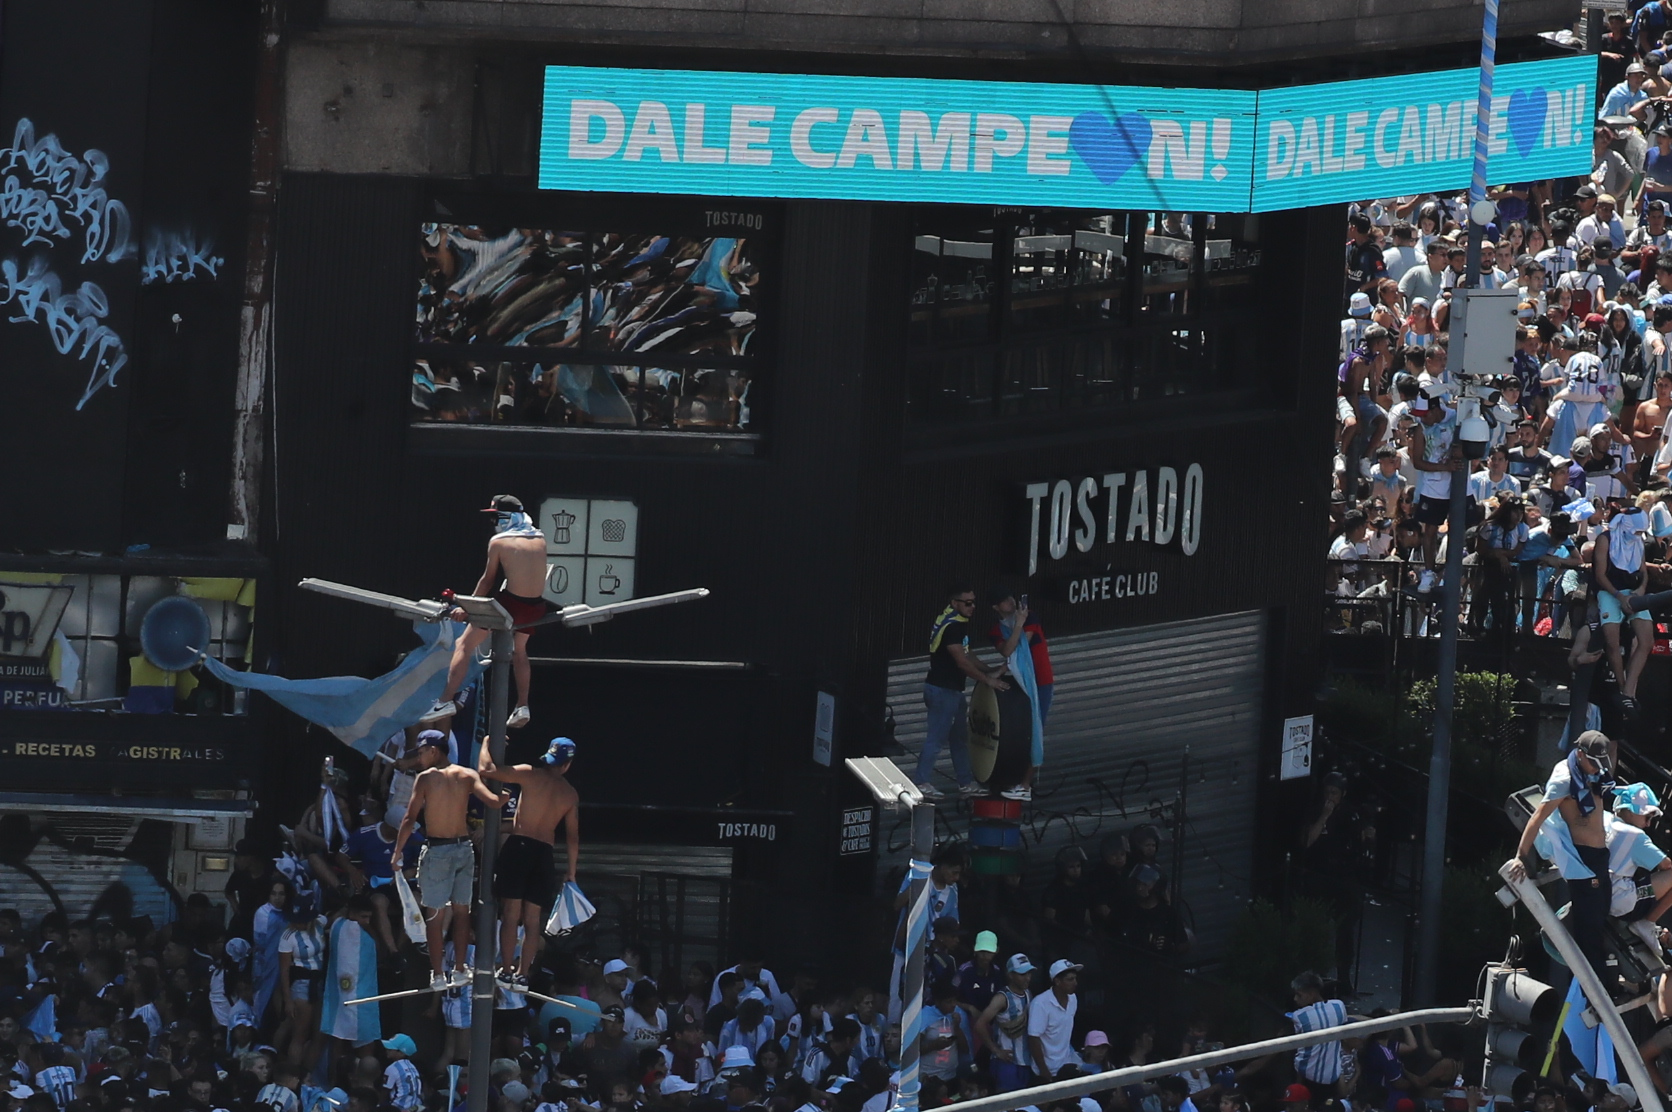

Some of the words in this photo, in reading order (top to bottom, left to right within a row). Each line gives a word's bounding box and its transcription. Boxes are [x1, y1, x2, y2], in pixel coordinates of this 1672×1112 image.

[568, 99, 776, 166] DALE
[1266, 110, 1369, 181] DALE
[705, 211, 762, 230] TOSTADO
[1026, 462, 1204, 577] TOSTADO
[1069, 563, 1111, 604] CAFÉ
[1115, 571, 1159, 598] CLUB
[6, 665, 18, 675] DE
[1289, 725, 1310, 739] TOSTADO
[15, 742, 96, 757] RECETAS
[112, 745, 224, 760] AGISTRALES
[718, 823, 775, 840] TOSTADO
[866, 1035, 875, 1047] 10
